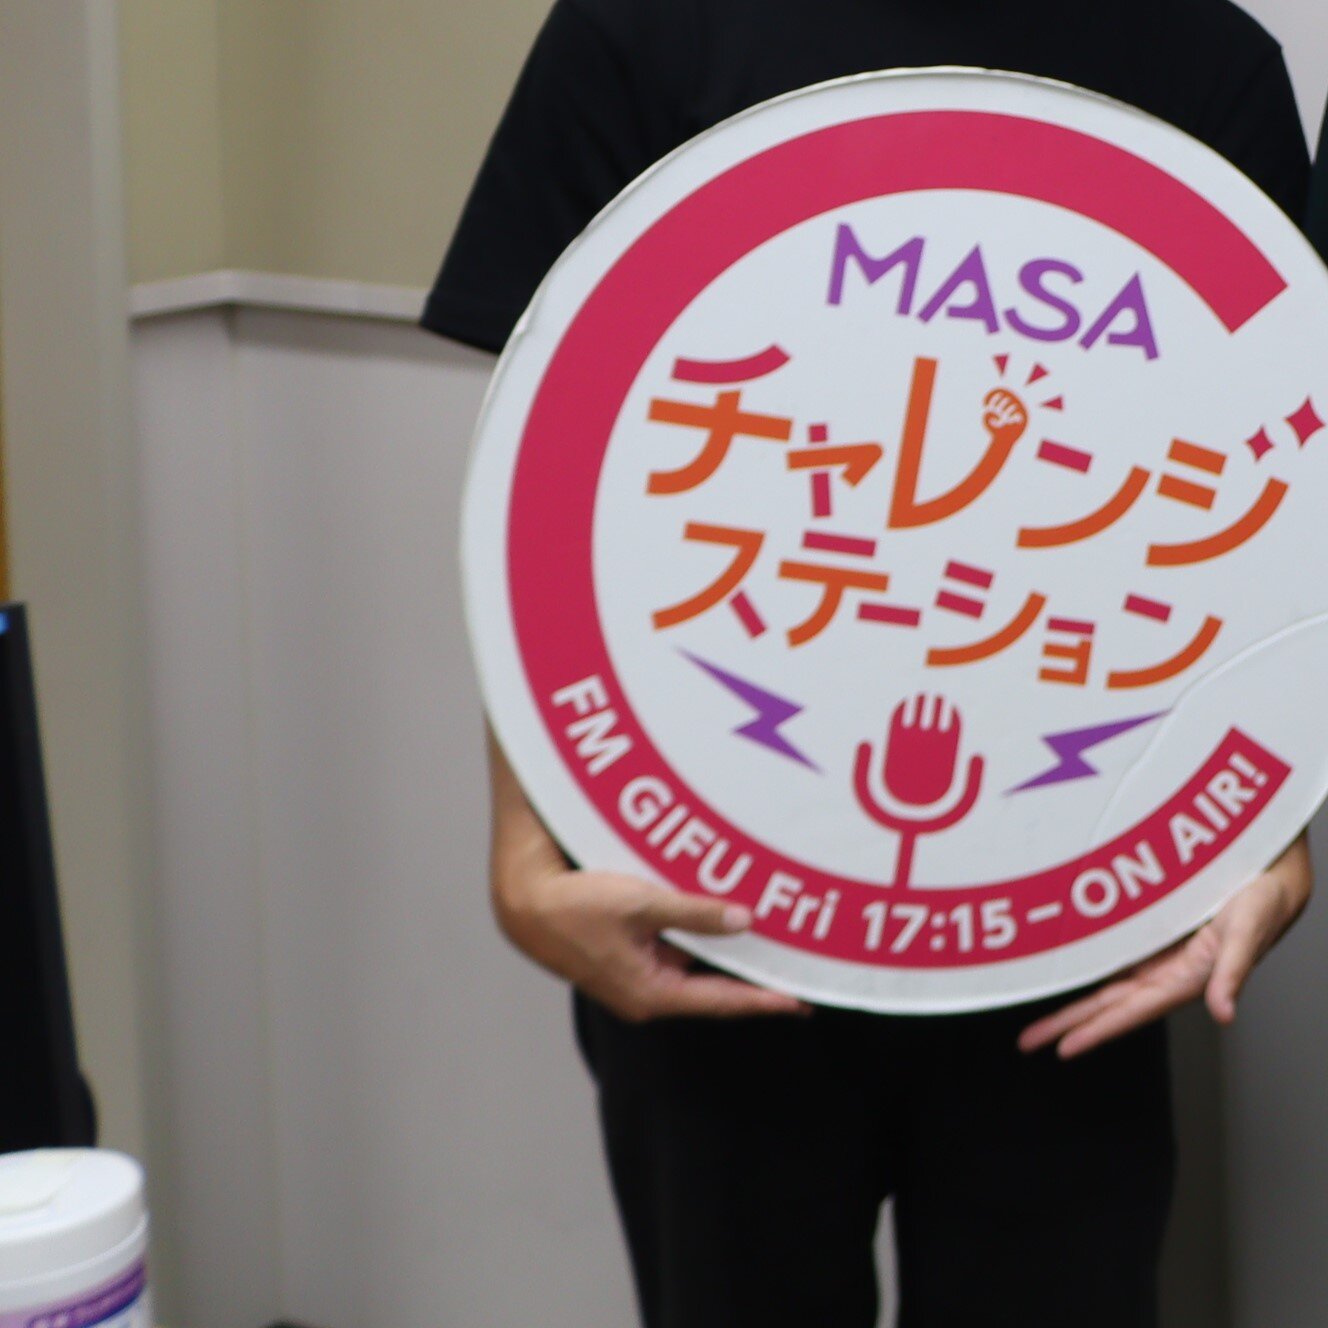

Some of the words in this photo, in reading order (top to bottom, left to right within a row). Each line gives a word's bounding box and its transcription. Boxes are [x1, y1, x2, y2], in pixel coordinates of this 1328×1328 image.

[827, 222, 1160, 362] MASA
[645, 343, 1327, 568] チャレンジ
[651, 520, 1224, 690] ステーション
[552, 674, 633, 776] FM
[617, 775, 753, 895] GIFU
[755, 871, 841, 940] Fri
[1167, 752, 1268, 867] AIR!
